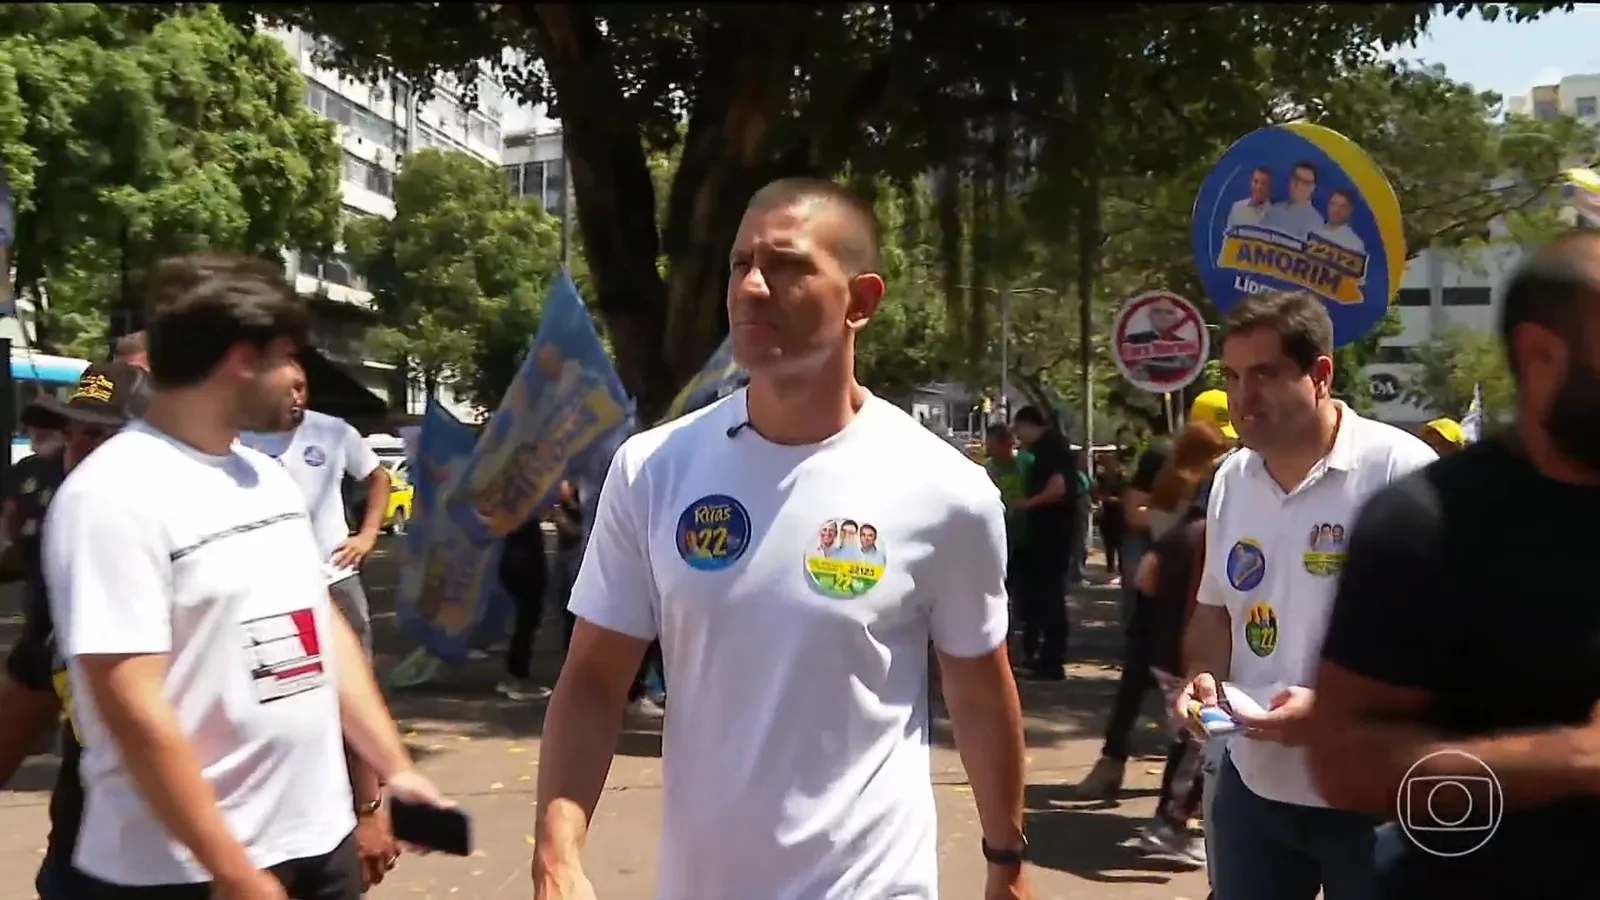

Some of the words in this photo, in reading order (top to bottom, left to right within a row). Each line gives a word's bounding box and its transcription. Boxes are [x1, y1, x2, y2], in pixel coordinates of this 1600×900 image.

[1237, 243, 1341, 293] AMORIM
[699, 527, 727, 557] 22
[1261, 628, 1274, 648] 22
